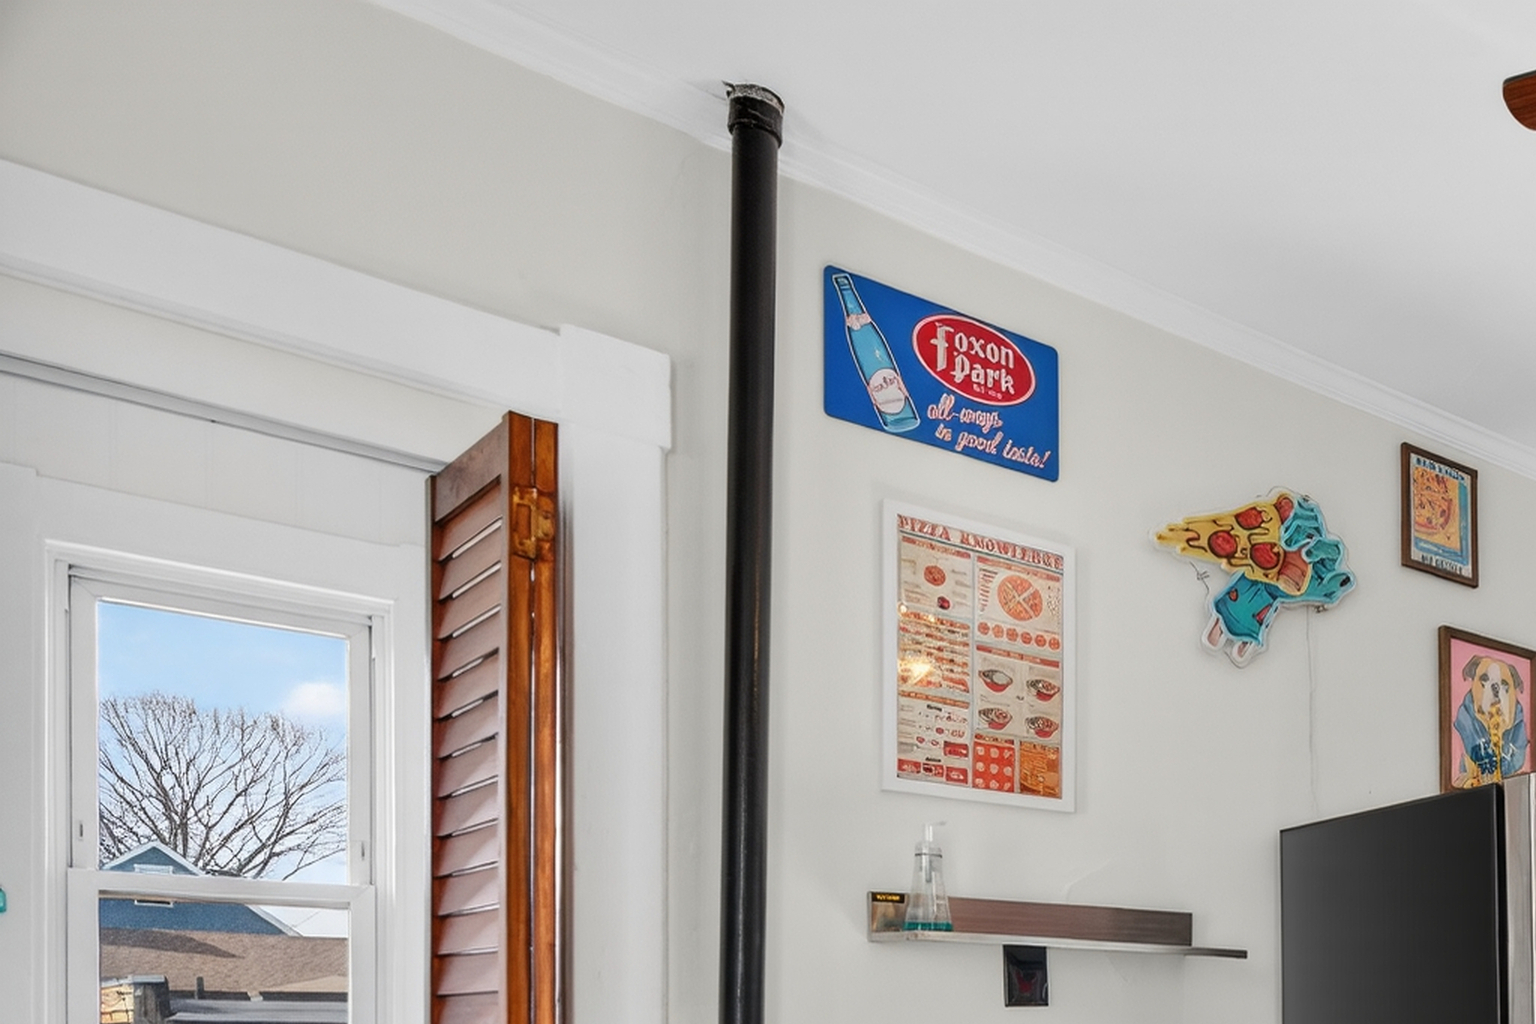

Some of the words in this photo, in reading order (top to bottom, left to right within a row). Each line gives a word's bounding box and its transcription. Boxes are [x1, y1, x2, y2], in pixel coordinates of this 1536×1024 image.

[930, 322, 1014, 371] Foxon
[950, 351, 1015, 395] Park
[955, 431, 1004, 455] good
